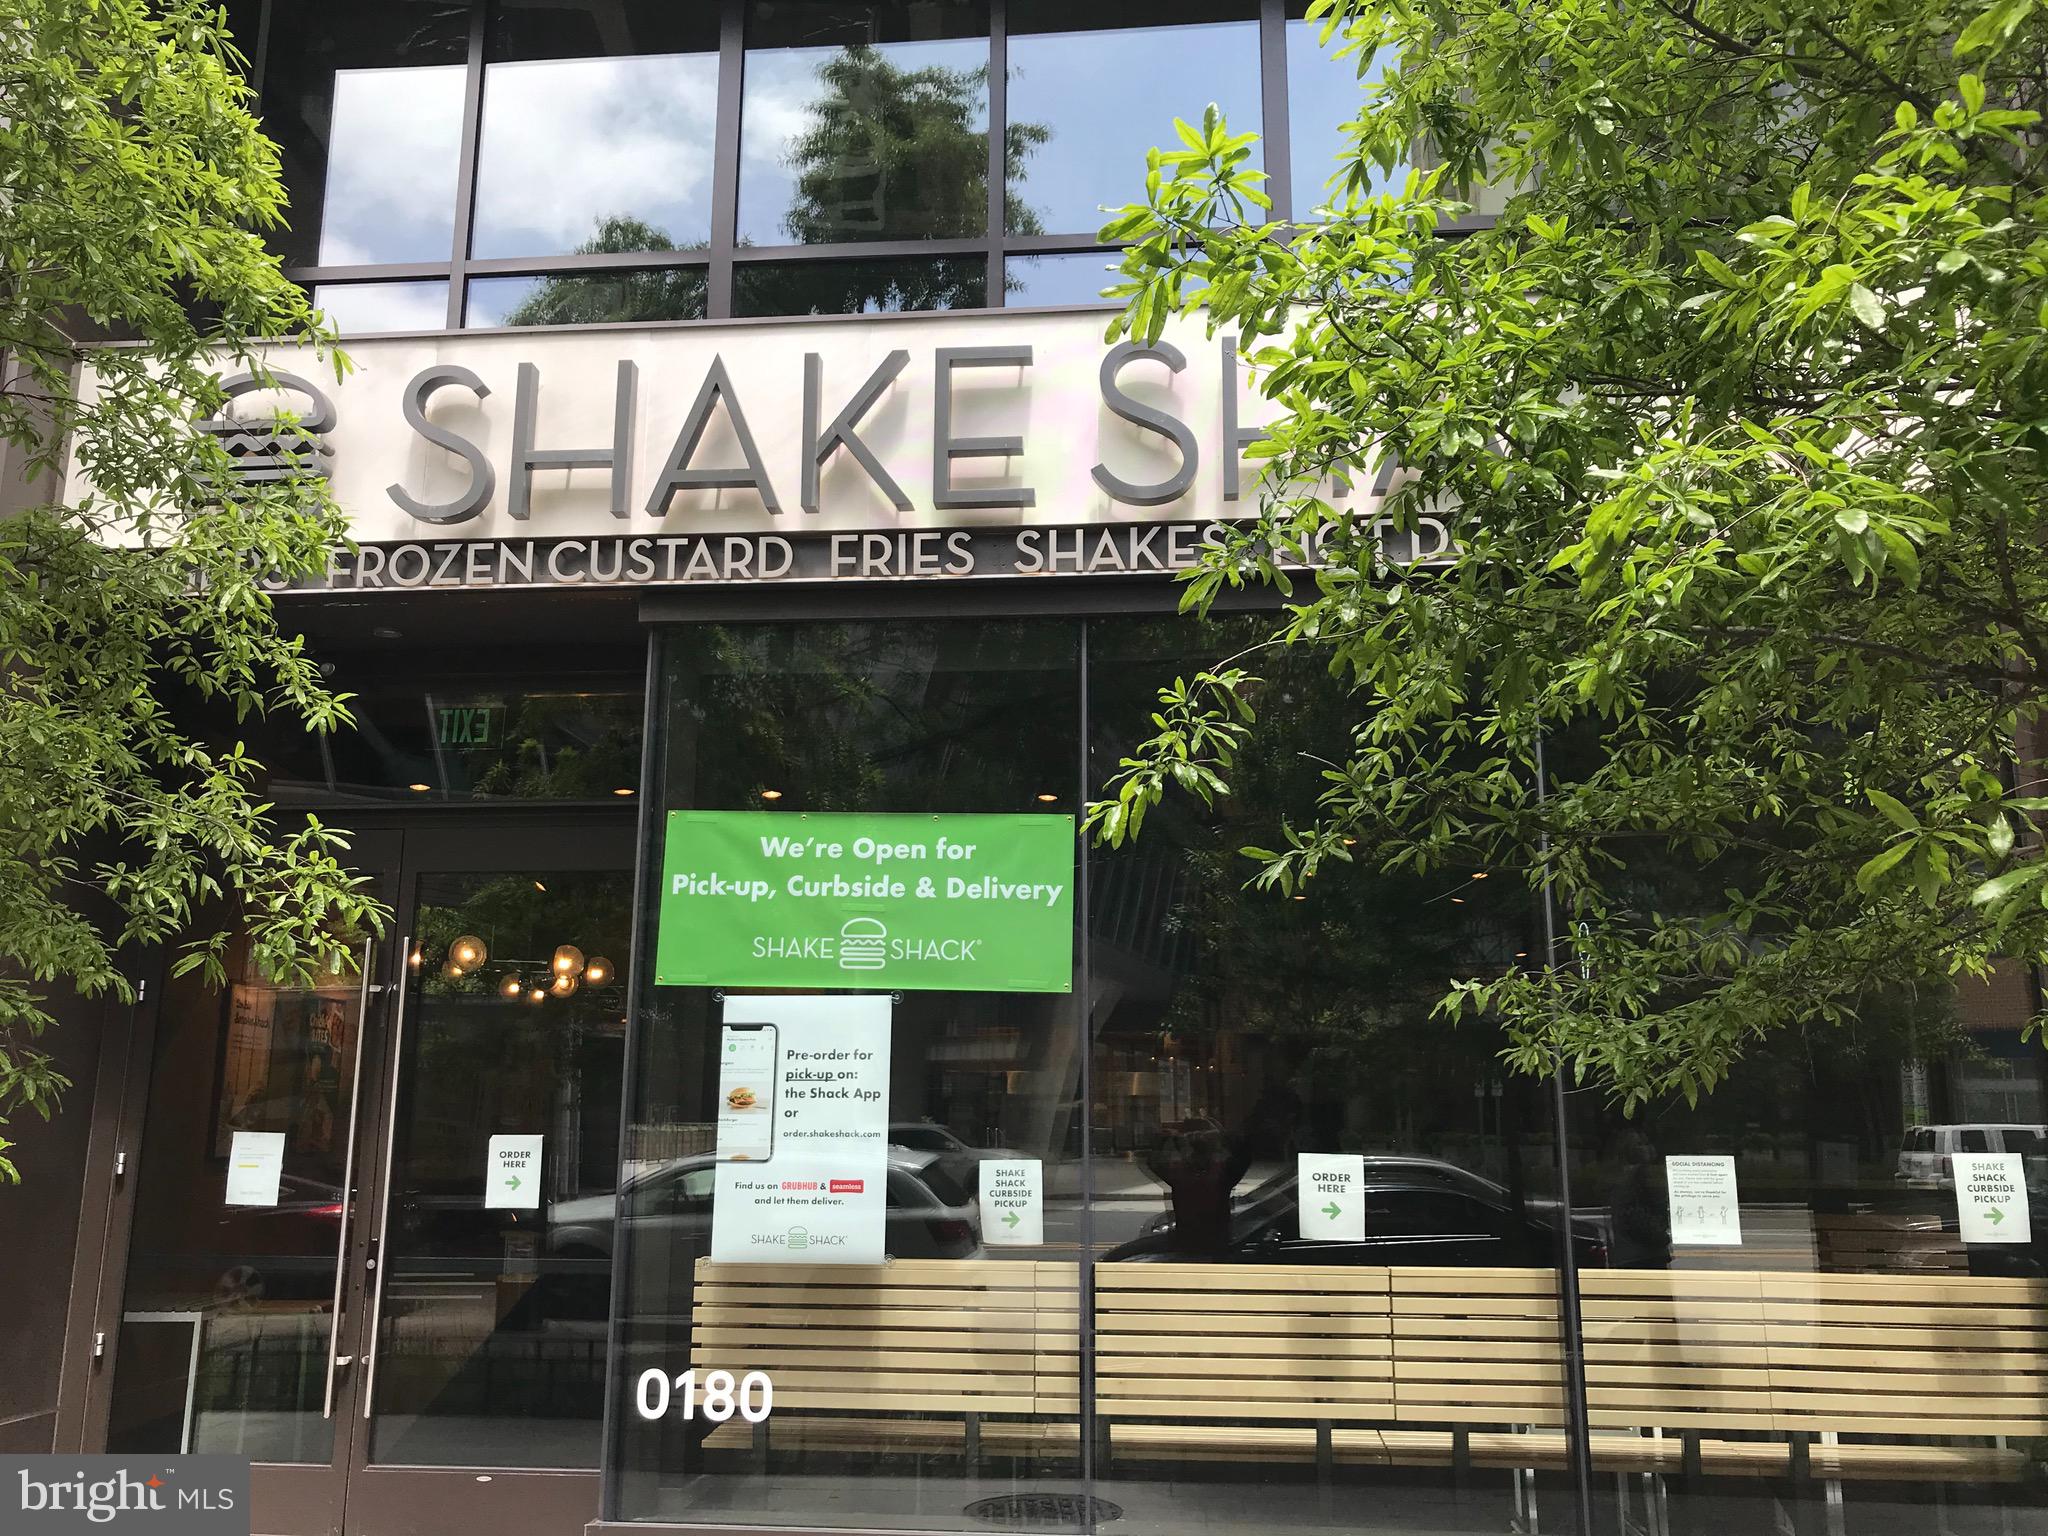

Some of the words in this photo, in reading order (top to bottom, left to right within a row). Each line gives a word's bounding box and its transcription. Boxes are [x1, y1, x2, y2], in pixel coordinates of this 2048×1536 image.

[386, 345, 1037, 526] SHAKE
[326, 540, 534, 588] FROZEN
[547, 536, 794, 584] CUSTARD
[830, 531, 975, 578] FRIES
[760, 836, 843, 858] We're
[853, 837, 927, 865] Open
[936, 836, 977, 860] for
[672, 872, 777, 902] Pick-up,
[787, 873, 906, 898] Curbside
[915, 876, 937, 898] &
[947, 876, 1064, 907] Delivery
[752, 936, 835, 959] SHAKE
[787, 1048, 851, 1060] Pre-order
[854, 1048, 873, 1060] for
[785, 1067, 834, 1082] pick-up
[837, 1071, 858, 1079] on:
[785, 1087, 806, 1098] the
[809, 1087, 849, 1098] Shack
[853, 1088, 881, 1102] App
[784, 1109, 799, 1118] or
[783, 1129, 881, 1138] order.shakeshack.com
[499, 1151, 531, 1159] ORDER
[503, 1160, 527, 1168] HERE
[1971, 1162, 2005, 1171] SHAKE
[995, 1169, 1026, 1177] SHAKE
[1312, 1172, 1351, 1182] ORDER
[1972, 1173, 2007, 1181] SHACK
[735, 1181, 753, 1190] Find
[782, 1181, 818, 1190] GRUBHUB
[820, 1182, 827, 1190] &
[995, 1179, 1026, 1187] SHACK
[1317, 1183, 1346, 1193] HERE
[1967, 1184, 2016, 1192] CURBSIDE
[989, 1190, 1033, 1198] CURBSIDE
[754, 1196, 771, 1205] and
[773, 1196, 785, 1205] let
[786, 1196, 809, 1205] them
[811, 1197, 845, 1206] deliver.
[1974, 1195, 2011, 1203] PICKUP
[994, 1200, 1028, 1208] PICKUP
[751, 1233, 786, 1244] SHAKE
[636, 1368, 773, 1423] 0180
